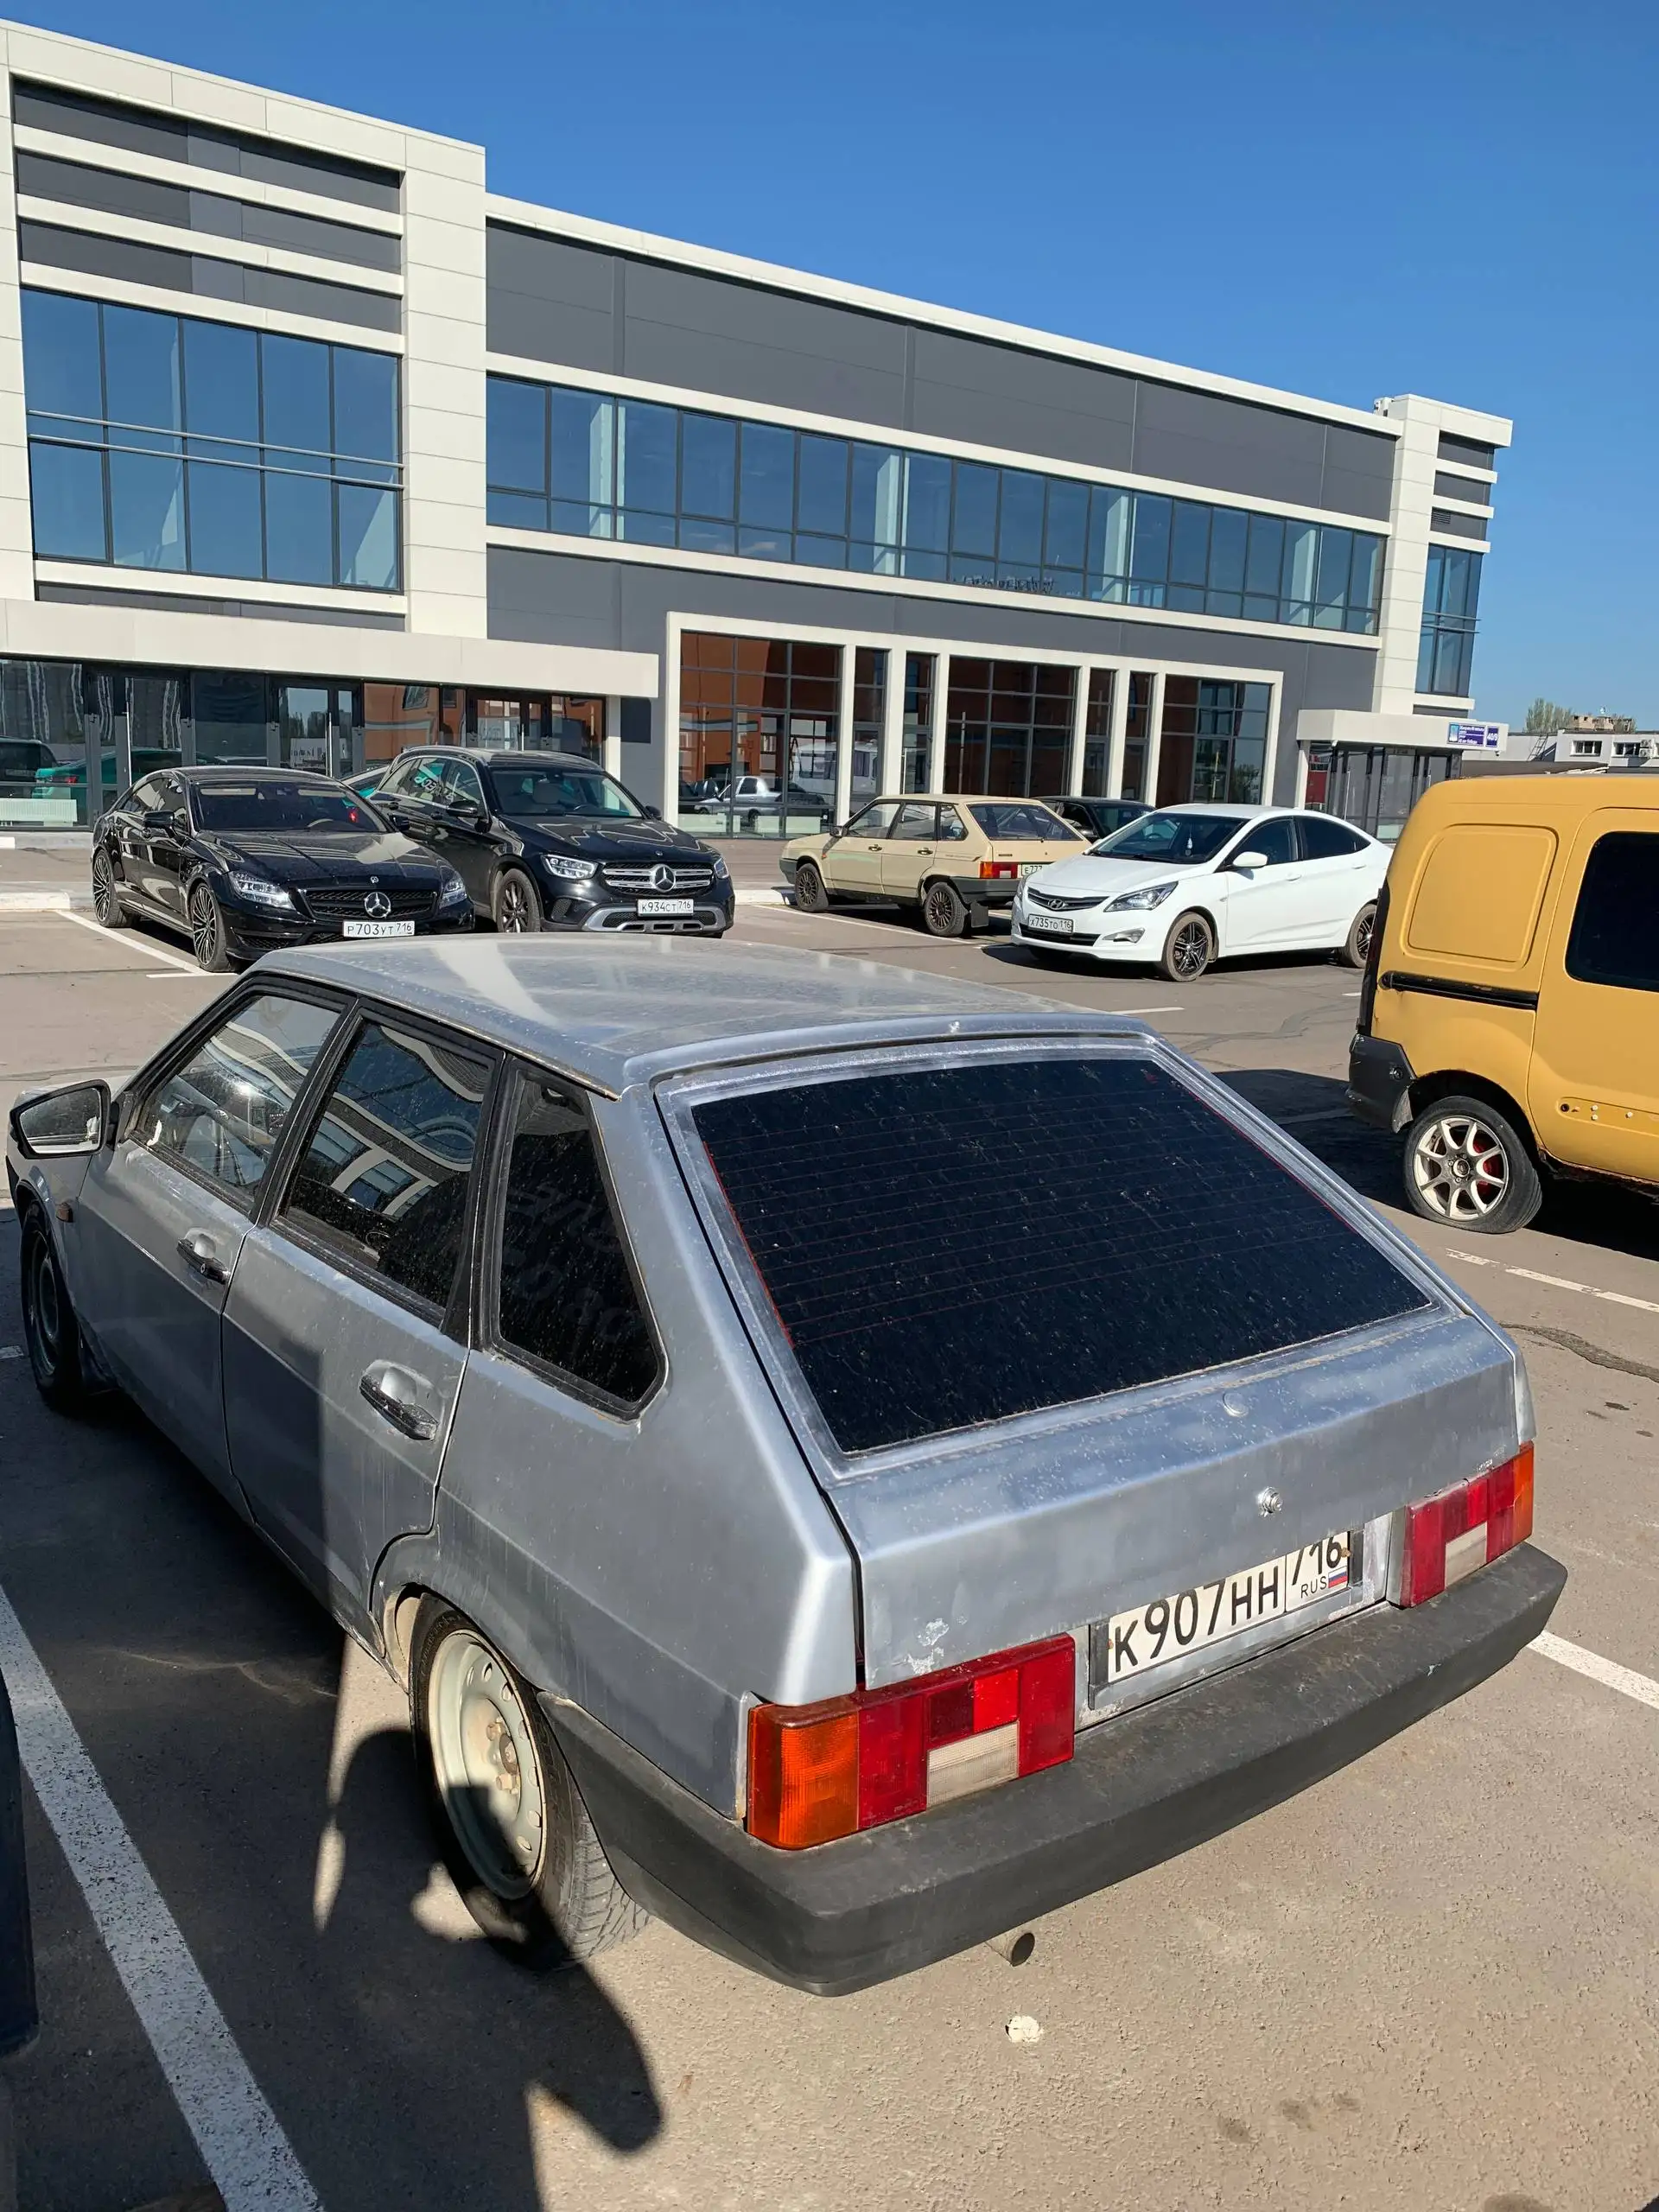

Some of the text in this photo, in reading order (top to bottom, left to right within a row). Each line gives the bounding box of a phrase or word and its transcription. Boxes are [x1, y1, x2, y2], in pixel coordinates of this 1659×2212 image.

[678, 900, 691, 909] 716
[347, 923, 412, 936] Р703УТ 716
[1300, 1577, 1327, 1599] RUS
[1114, 1565, 1279, 1673] К907НН
